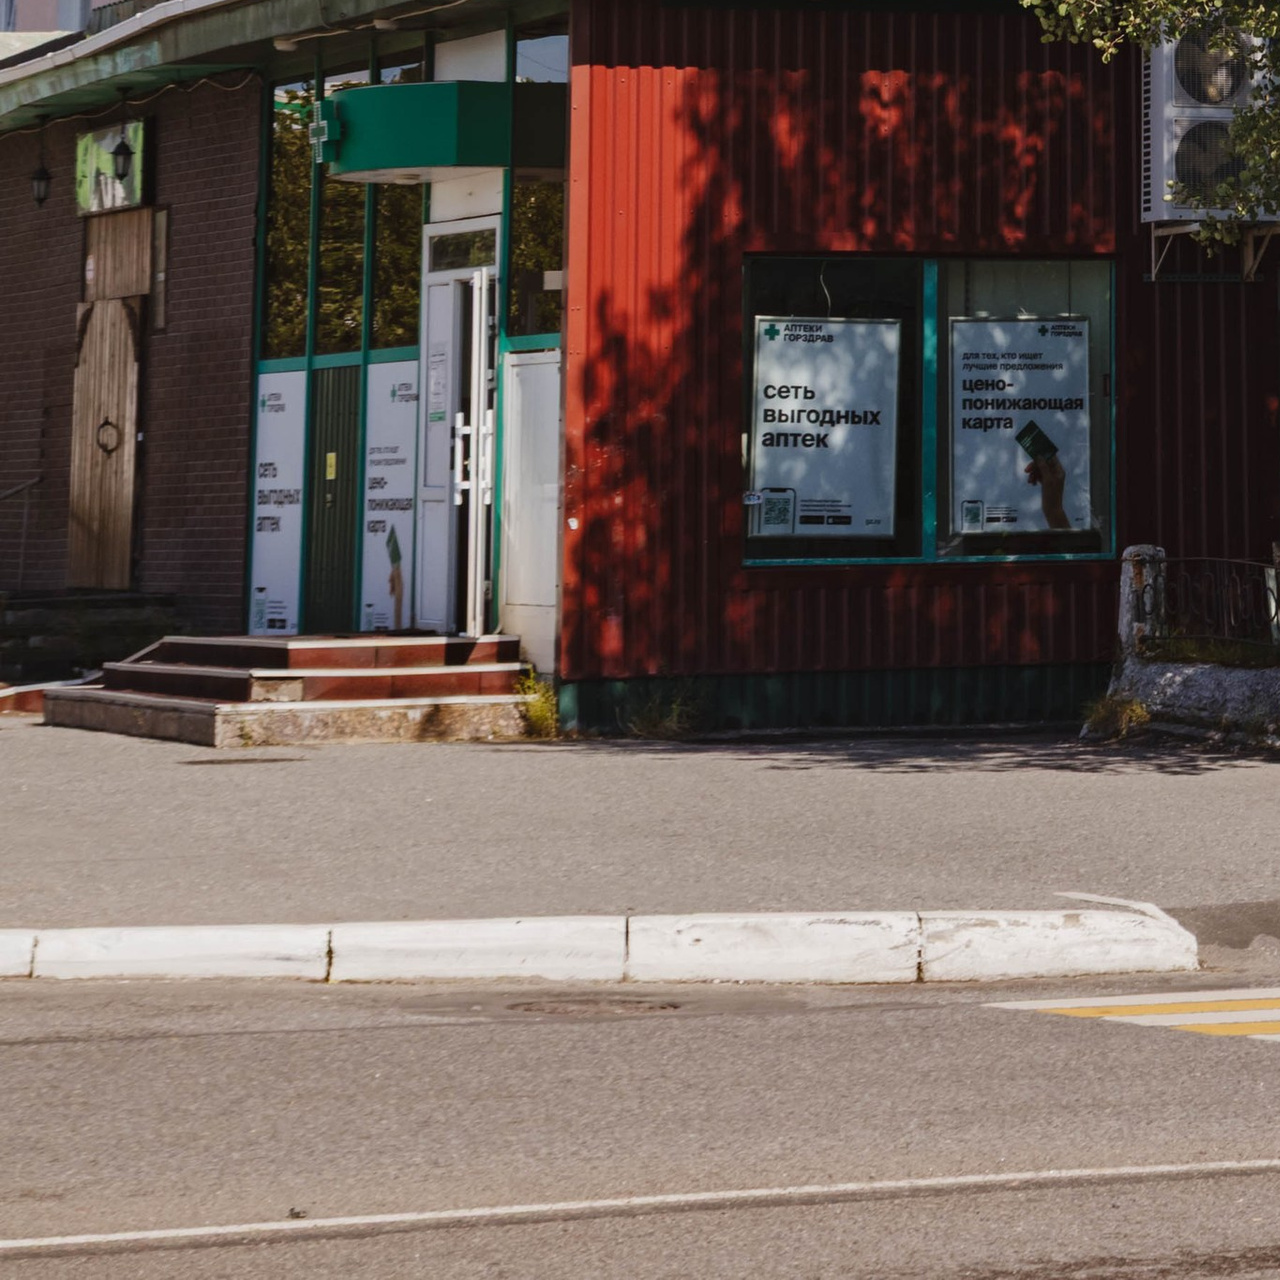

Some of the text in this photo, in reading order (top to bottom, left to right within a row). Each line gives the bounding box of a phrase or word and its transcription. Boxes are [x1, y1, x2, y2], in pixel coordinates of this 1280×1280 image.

[783, 324, 822, 333] АПТЕКИ
[783, 334, 834, 343] ГОРЗДРАВ
[763, 384, 816, 400] сеть
[962, 378, 1014, 393] цено-
[962, 398, 1084, 412] понижающая
[763, 408, 881, 427] выгодных
[962, 416, 1013, 432] карта
[761, 432, 829, 448] аптек
